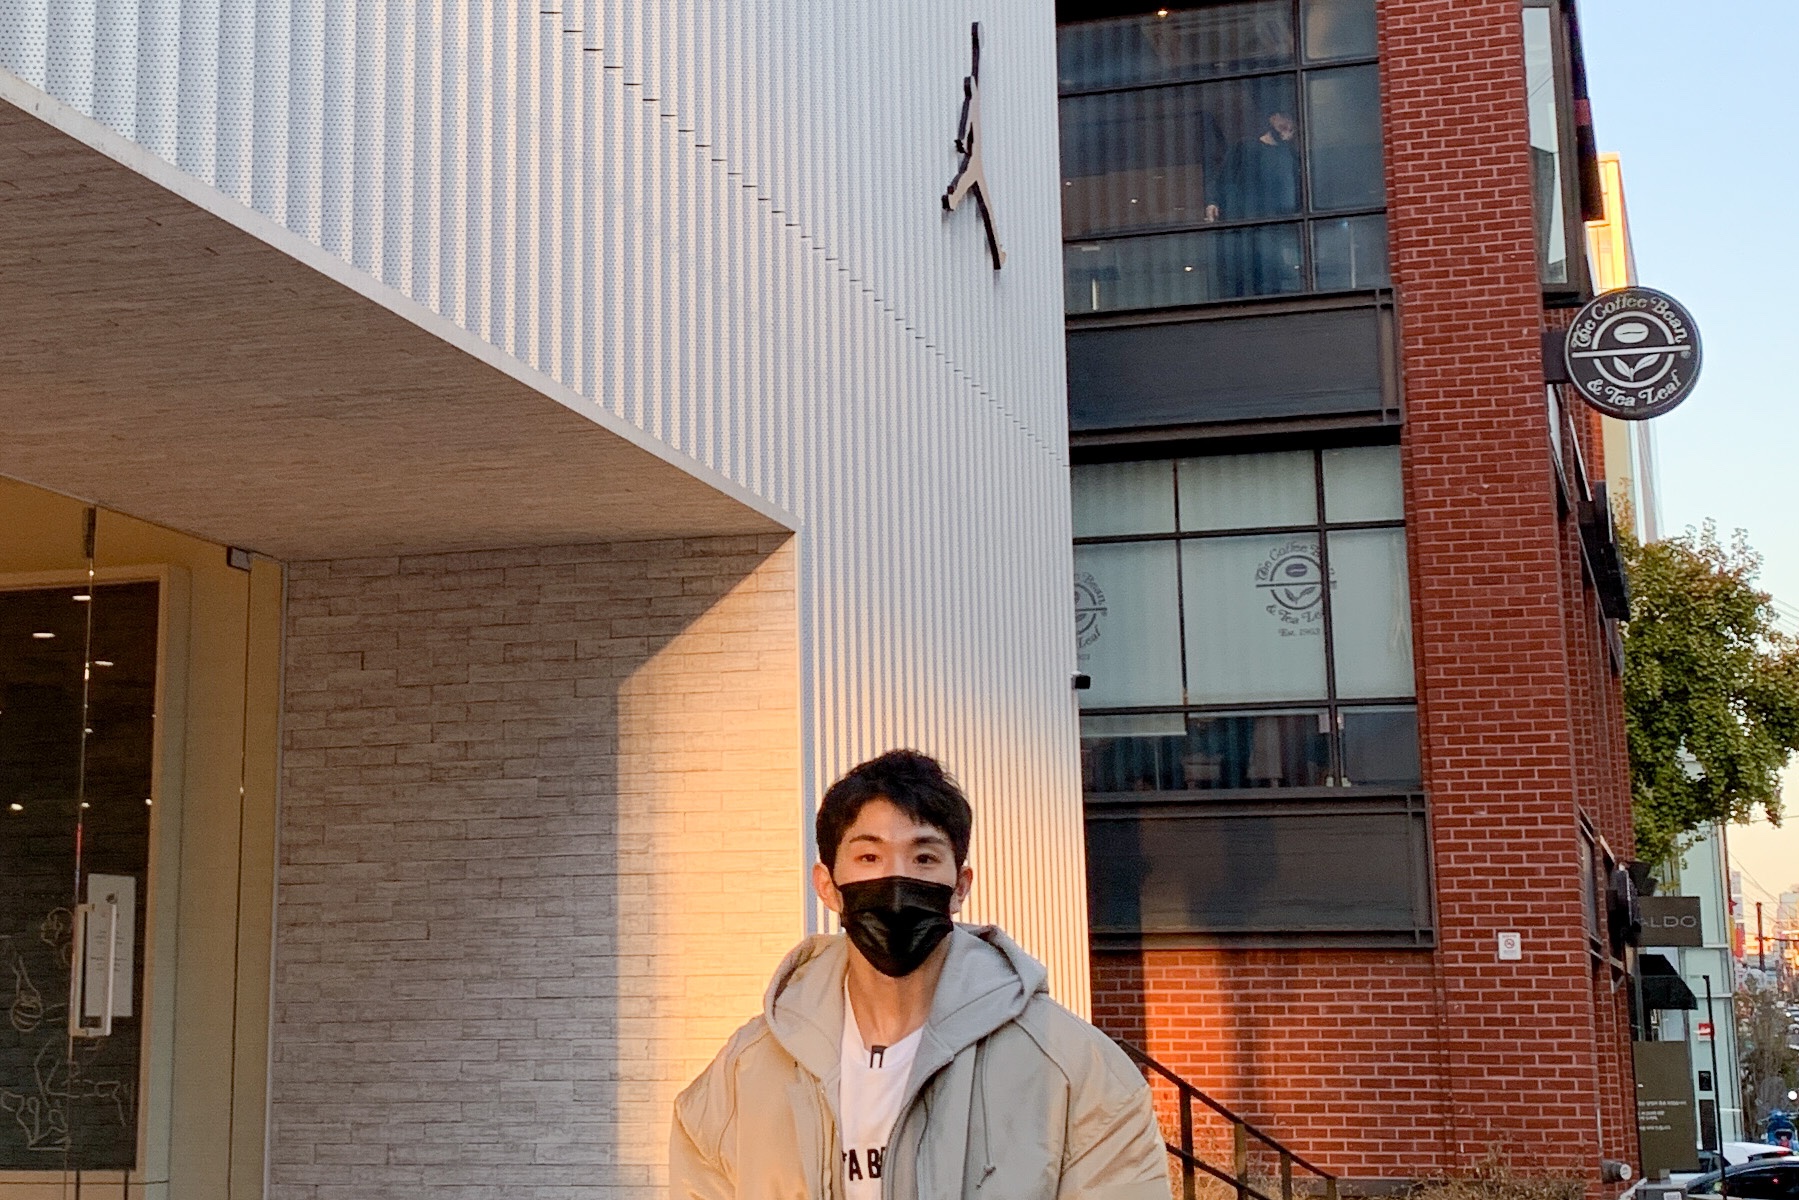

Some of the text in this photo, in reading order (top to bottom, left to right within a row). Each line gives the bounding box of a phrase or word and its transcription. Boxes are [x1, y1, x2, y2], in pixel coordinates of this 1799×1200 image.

[1571, 295, 1688, 348] The Coffee Bean
[1586, 369, 1682, 407] & Tea Leaf
